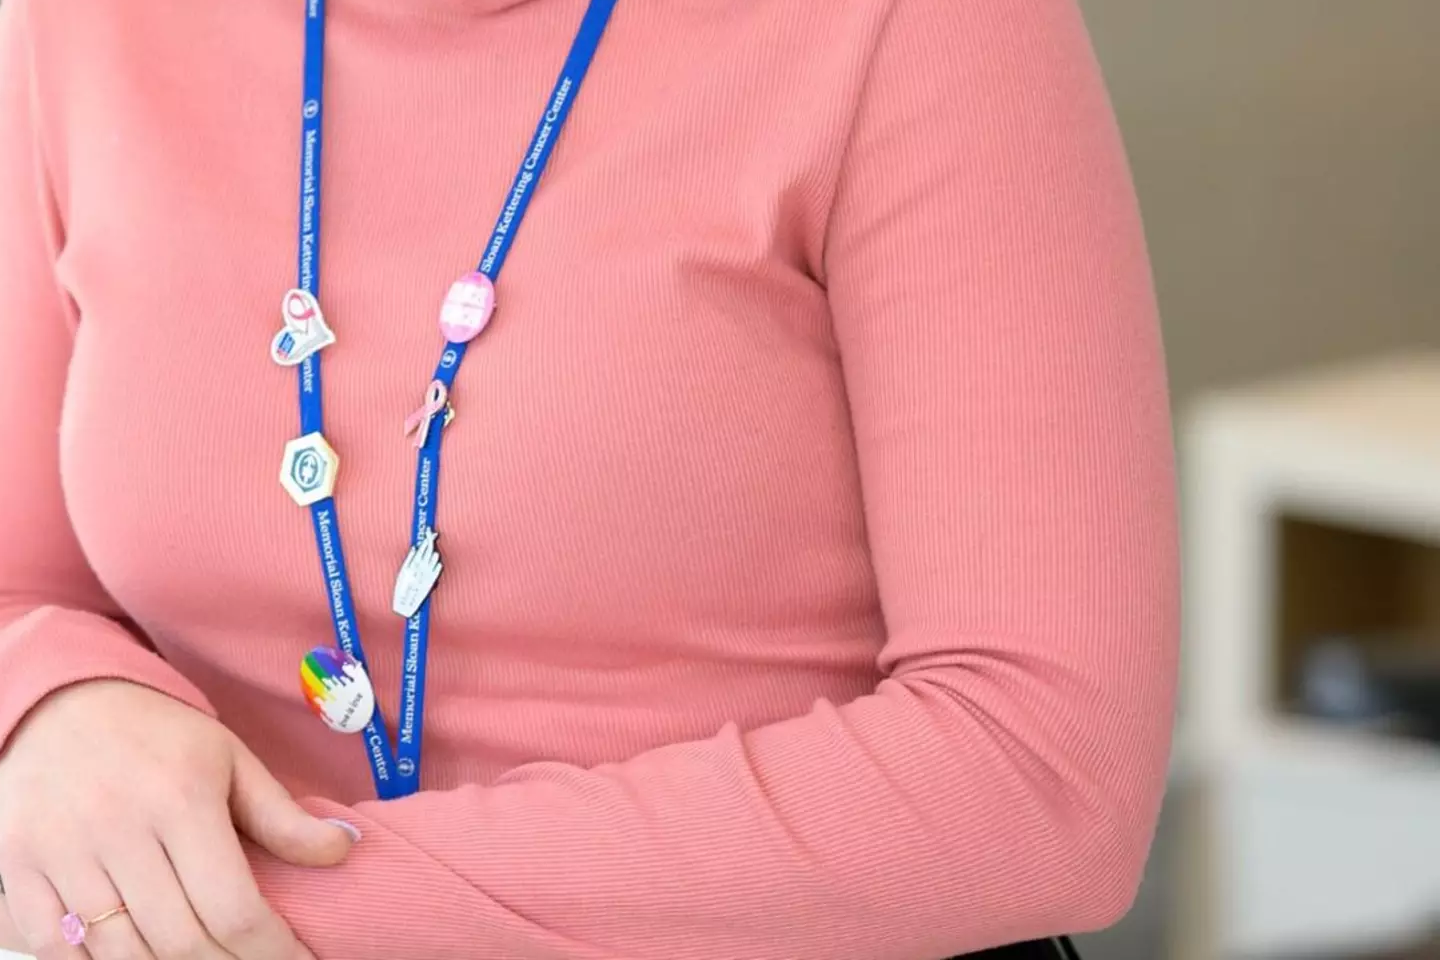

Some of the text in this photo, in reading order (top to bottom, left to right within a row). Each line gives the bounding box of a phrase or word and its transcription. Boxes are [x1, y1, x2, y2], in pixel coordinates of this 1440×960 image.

[303, 129, 317, 194] Memorial
[481, 76, 572, 273] Sloan Kettering Cancer Center
[302, 232, 315, 290] Ketterin
[303, 355, 315, 394] enter
[418, 457, 431, 507] Center
[317, 510, 340, 578] Memorial
[330, 579, 344, 619] Sloan
[406, 633, 418, 673] Sloan
[401, 675, 416, 744] Memorial
[369, 735, 389, 780] Center
